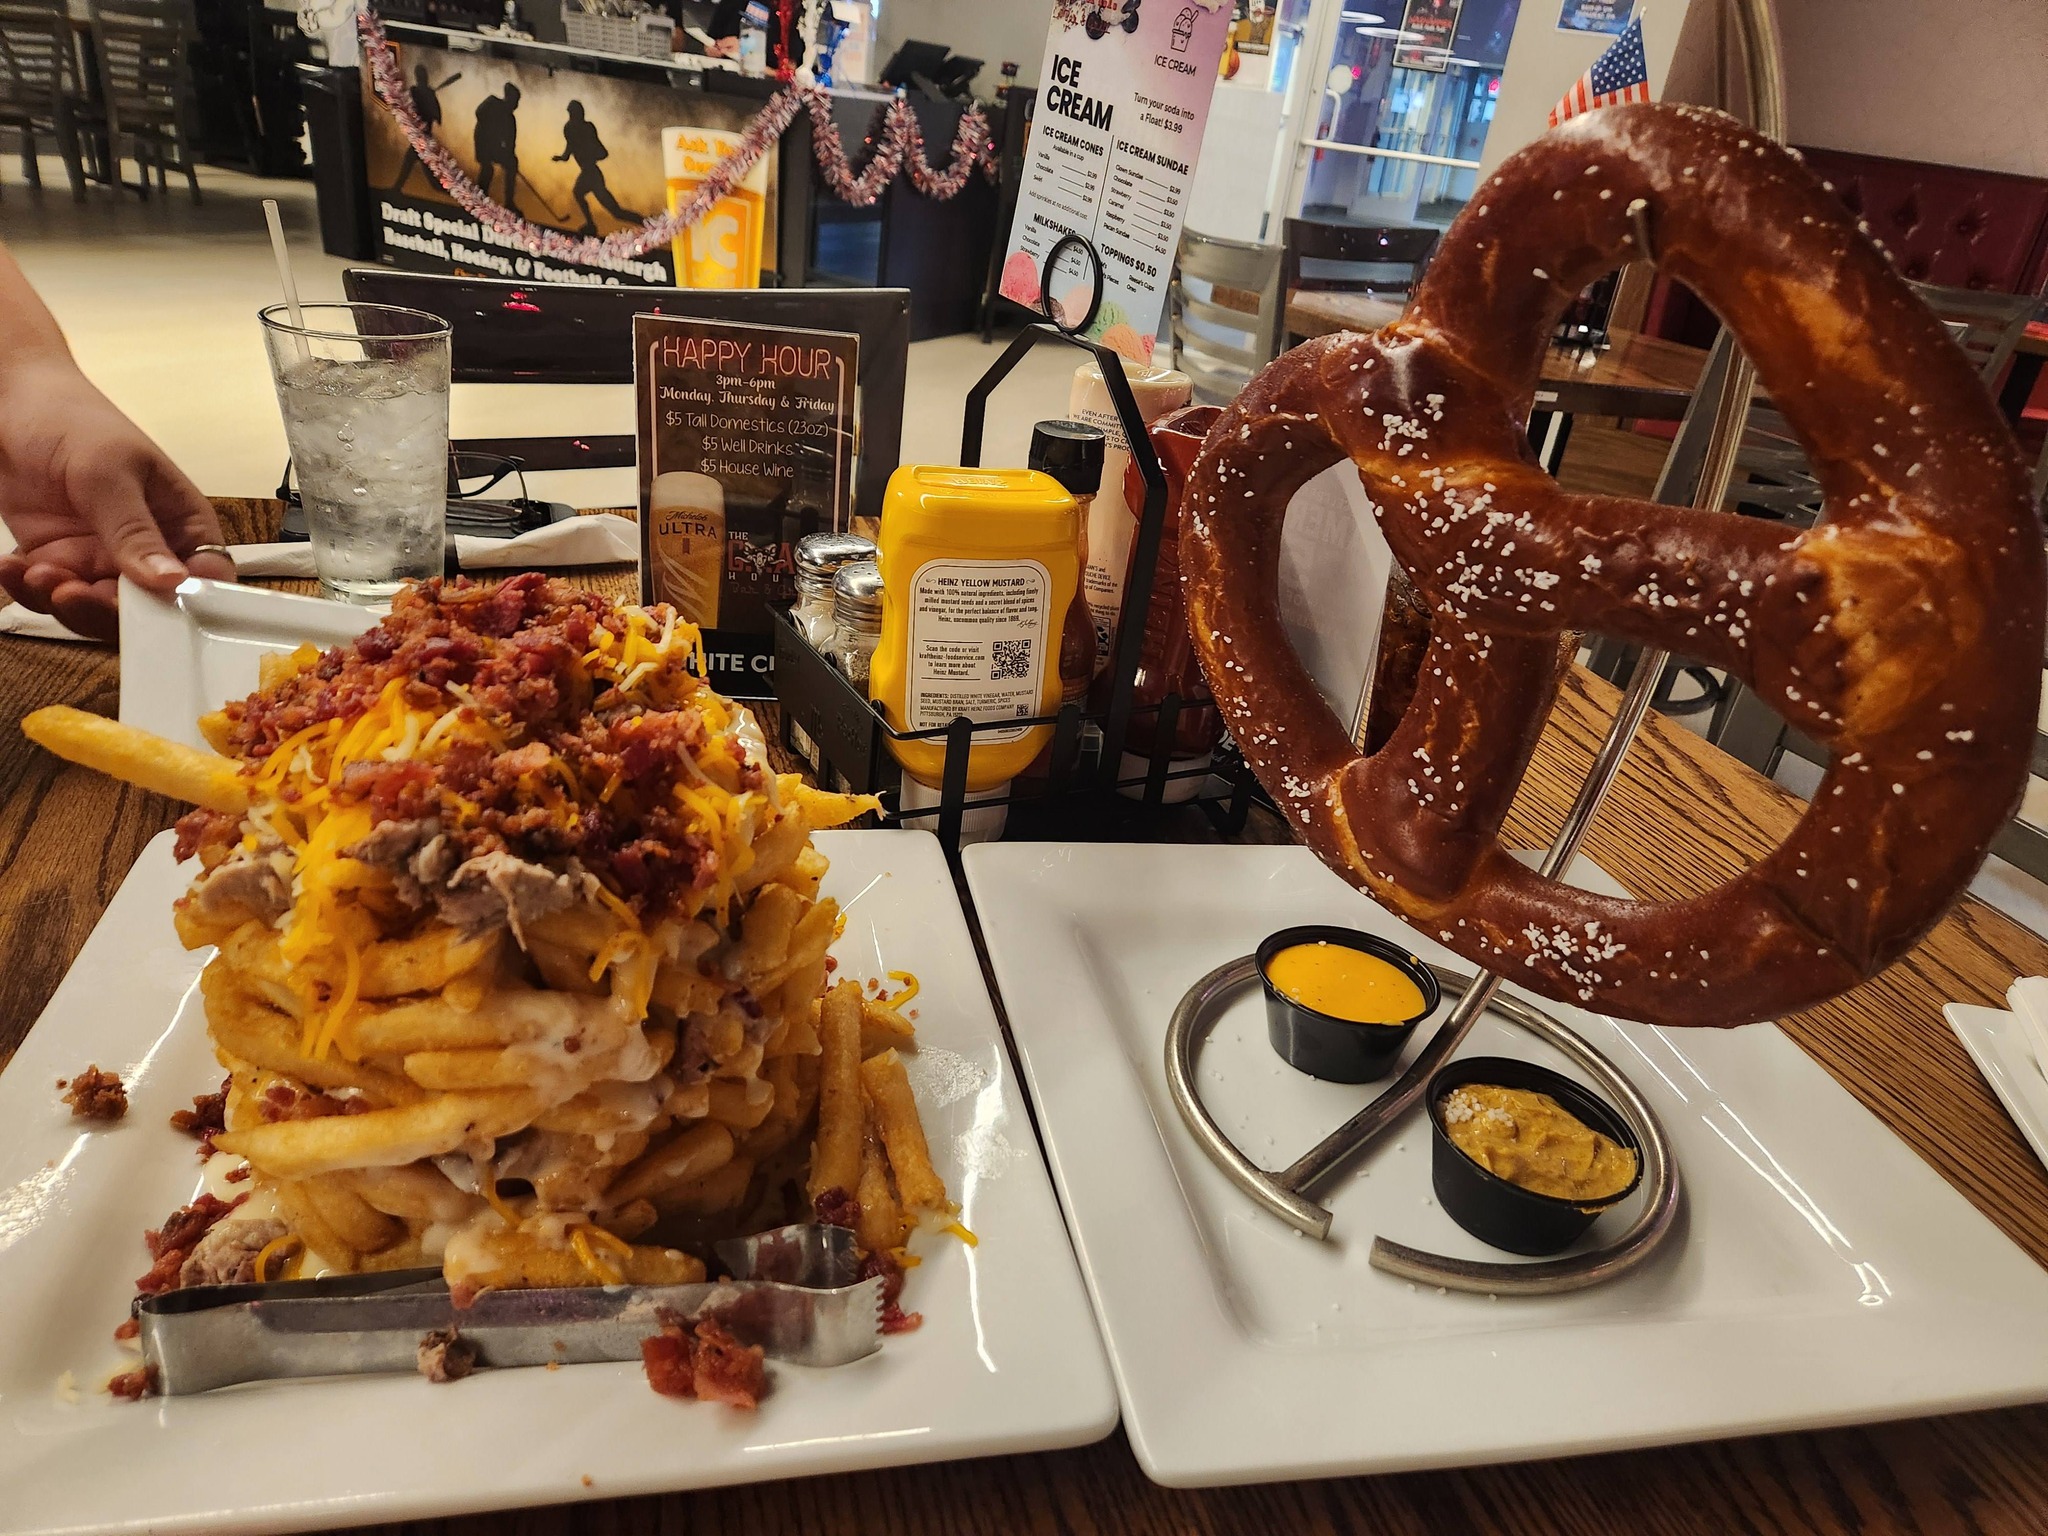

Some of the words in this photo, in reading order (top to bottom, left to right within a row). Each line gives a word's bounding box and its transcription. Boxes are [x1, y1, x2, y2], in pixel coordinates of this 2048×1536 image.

[1051, 54, 1082, 88] ICE
[1154, 54, 1168, 68] ICE
[1168, 58, 1197, 76] CREAM
[1046, 85, 1114, 132] CREAM
[1134, 92, 1148, 106] Turn
[1149, 98, 1163, 112] your
[1164, 103, 1180, 116] soda
[1181, 107, 1195, 120] into
[1145, 112, 1164, 128] Float!
[1164, 117, 1183, 134] $3.99
[1043, 125, 1054, 137] ICE
[1055, 130, 1080, 147] CREAM
[1080, 140, 1104, 156] CONES
[1053, 145, 1069, 155] Available
[1038, 151, 1050, 160] Vanilla
[1087, 171, 1097, 180] $2.99
[1117, 140, 1129, 153] ICE
[1129, 145, 1156, 163] CREAM
[1157, 155, 1189, 175] SUNDAE
[1036, 163, 1054, 174] Chocolate
[1085, 182, 1095, 191] $2.99
[1116, 164, 1128, 174] Clown
[1128, 170, 1143, 180] Sundae
[1169, 185, 1181, 195] $2.99
[1082, 194, 1092, 203] $2.99
[1113, 175, 1133, 187] Chocolate
[1167, 197, 1178, 206] $3.50
[1062, 205, 1079, 216] additional
[1111, 187, 1132, 201] Strawberry
[1164, 209, 1175, 218] $3.50
[380, 201, 422, 228] Draft
[422, 212, 480, 242] Special
[1108, 199, 1124, 209] Caramel
[1161, 220, 1172, 230] $3.50
[1025, 224, 1037, 233] Vanilla
[1106, 211, 1125, 224] Raspberry
[1158, 233, 1169, 242] $3.50
[1022, 235, 1040, 247] Chocolate
[1104, 222, 1115, 232] Pecan
[1115, 228, 1130, 239] Sundae
[1155, 245, 1166, 255] $4.50
[383, 226, 450, 262] Baseball,
[450, 242, 514, 276] Hockey,
[515, 257, 532, 277] &
[533, 261, 603, 286] Football
[1020, 245, 1040, 259] Strawberry
[1101, 243, 1135, 267] TOPPINGS
[1135, 260, 1157, 277] $0.50
[1107, 274, 1119, 285] Pieces
[1129, 275, 1144, 286] Reese's
[1144, 282, 1155, 292] Cups
[1127, 284, 1137, 293] Oreo
[663, 336, 752, 373] HAPPY
[760, 344, 831, 380] HOUR
[716, 374, 776, 392] 3pm-6pm
[718, 390, 776, 410] Thursday
[780, 396, 790, 408] &
[794, 396, 835, 415] Friday
[1082, 409, 1097, 417] EVEN
[665, 410, 682, 426] $5
[686, 412, 707, 428] Tall
[710, 414, 785, 434] Domestics
[788, 420, 829, 438] (23oz)
[702, 435, 717, 451] $5
[720, 438, 746, 453] Well
[750, 439, 793, 456] Drinks
[701, 458, 716, 473] $5
[720, 459, 759, 475] House
[763, 463, 794, 478] Wine
[666, 510, 708, 522] Michelob
[659, 522, 717, 539] ULTRA
[728, 531, 748, 541] THE
[938, 578, 958, 586] HEINZ
[961, 578, 990, 587] YELLOW
[992, 578, 1024, 587] MUSTARD
[689, 652, 745, 672] HITE
[919, 652, 985, 661] kraftheinz-foodservice.com
